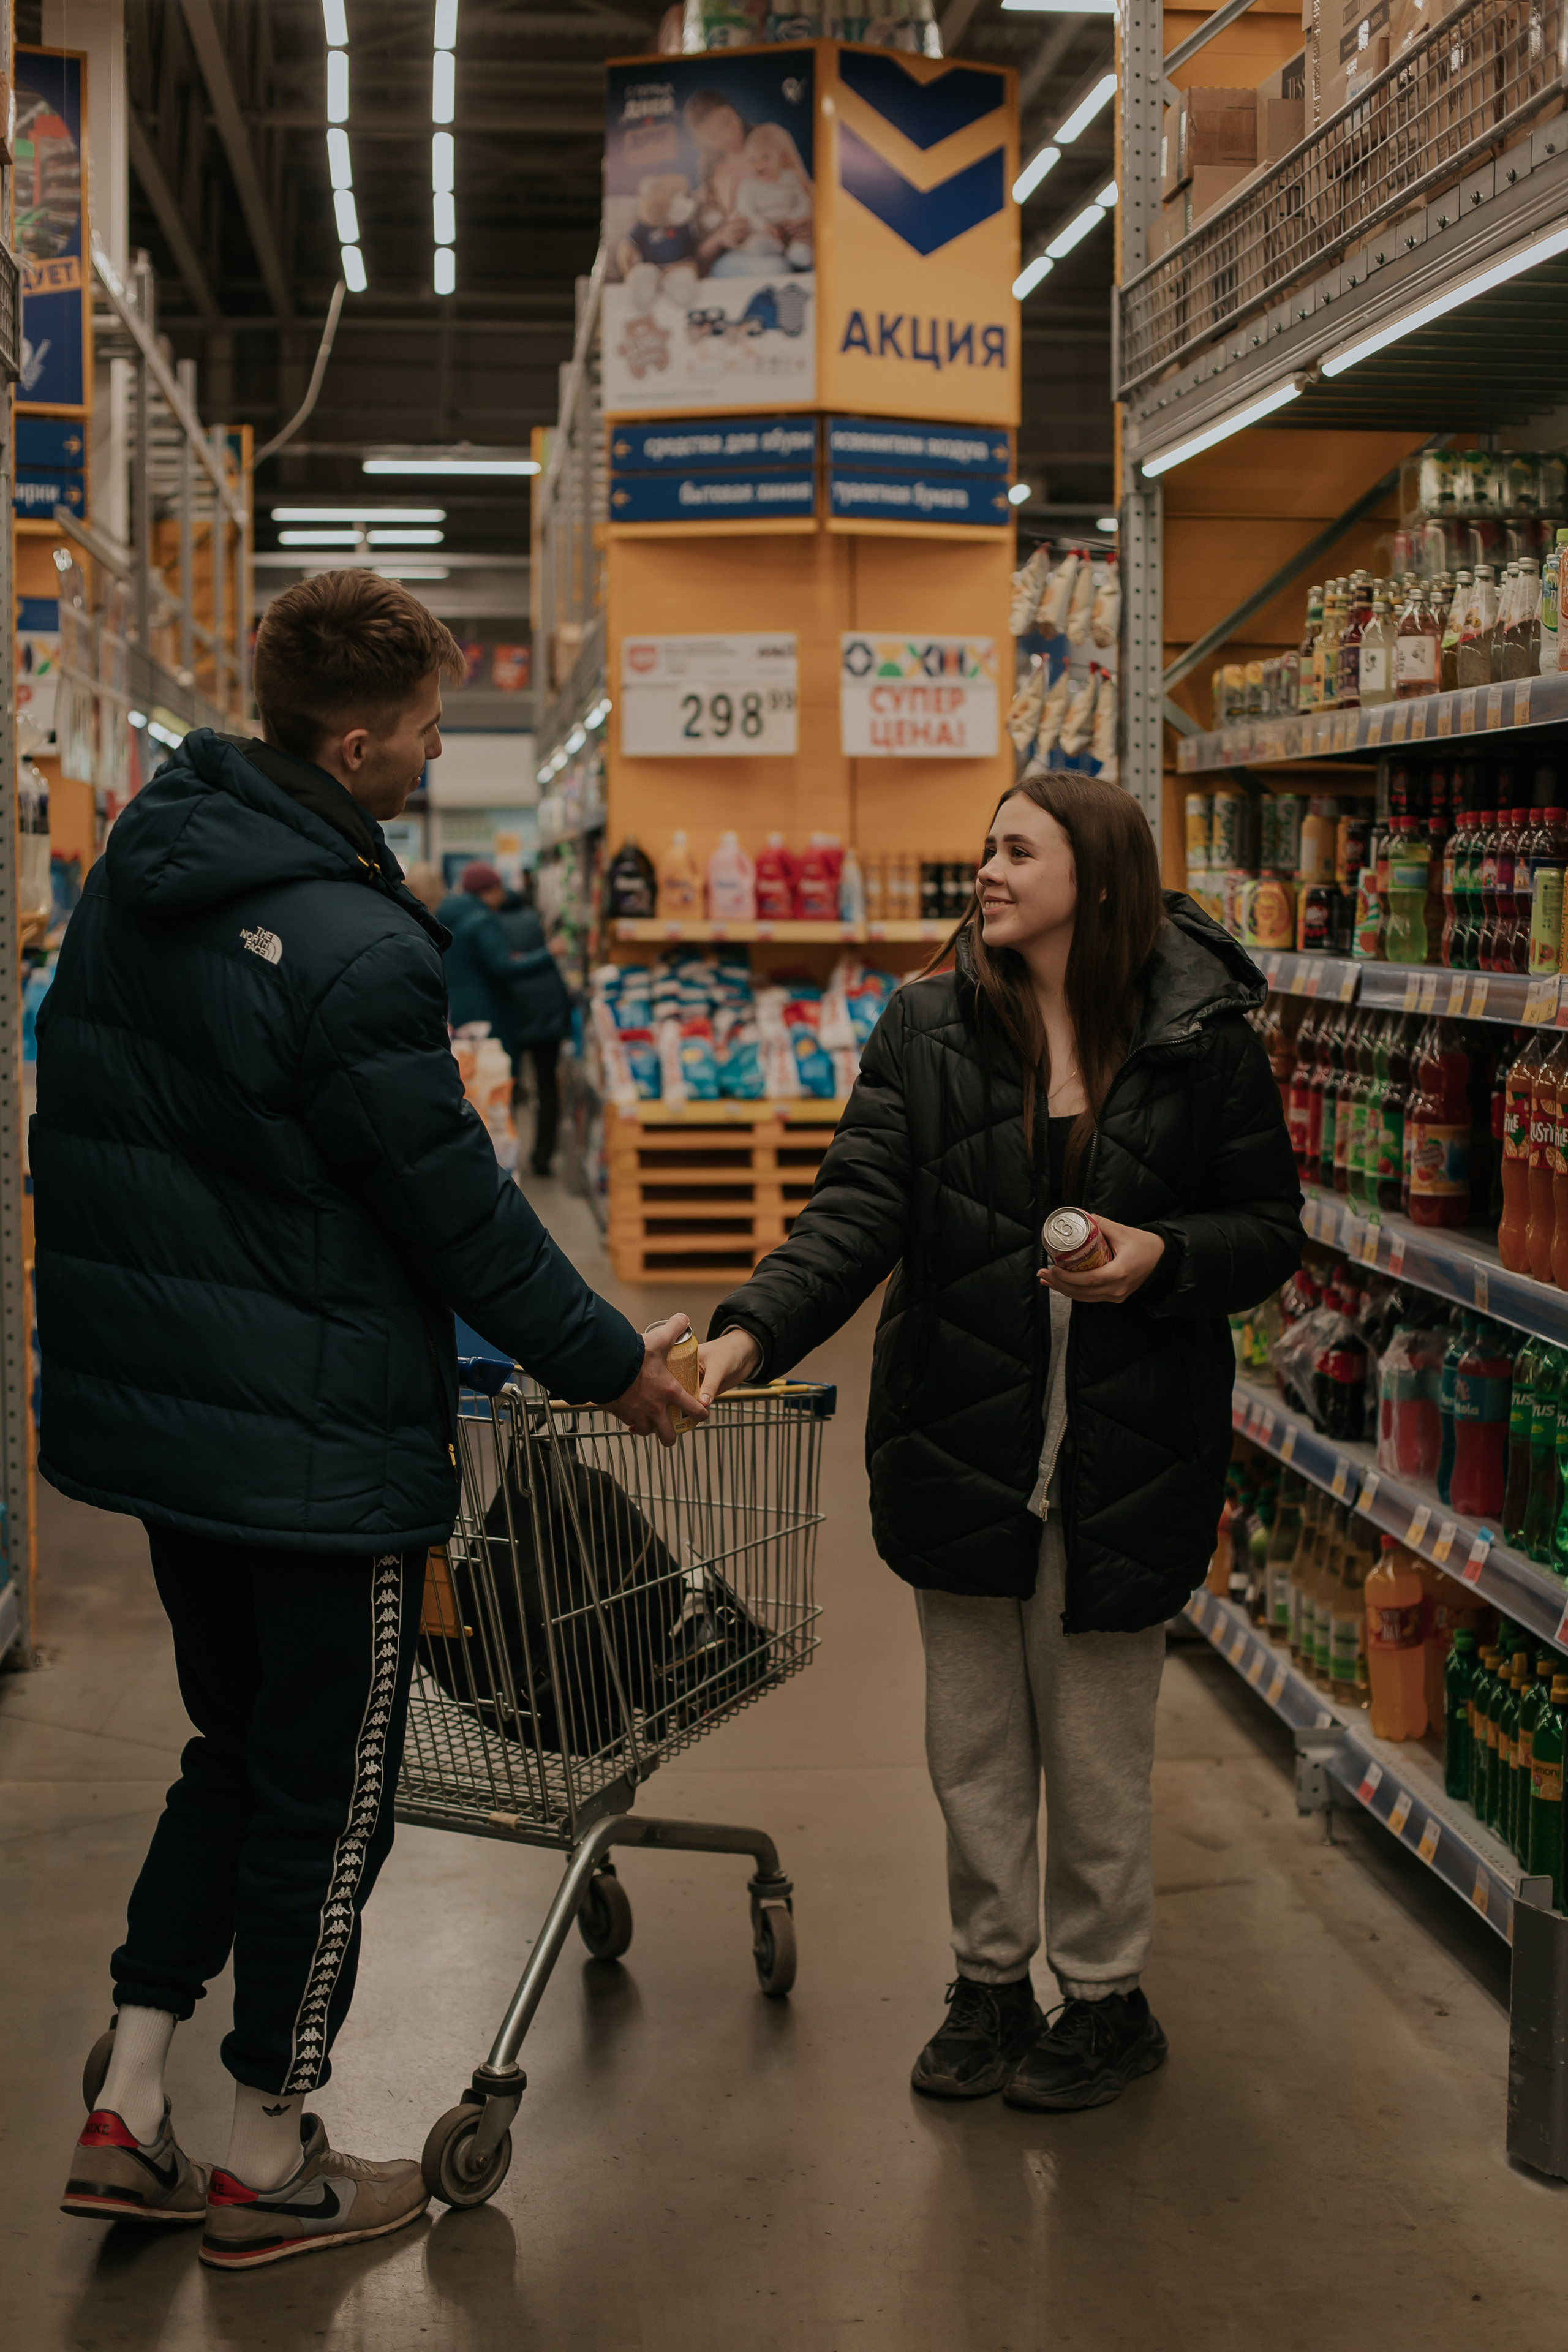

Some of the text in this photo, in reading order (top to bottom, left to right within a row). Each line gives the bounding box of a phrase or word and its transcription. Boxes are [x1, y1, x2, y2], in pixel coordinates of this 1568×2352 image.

[841, 309, 1005, 369] АКЦИЯ
[869, 685, 965, 715] СУПЕР
[682, 692, 763, 739] 298
[870, 719, 965, 751] ЦЕНА!
[239, 928, 270, 949] NORTH
[256, 925, 273, 941] THE
[244, 940, 265, 956] FACE
[1532, 1403, 1556, 1417] rus
